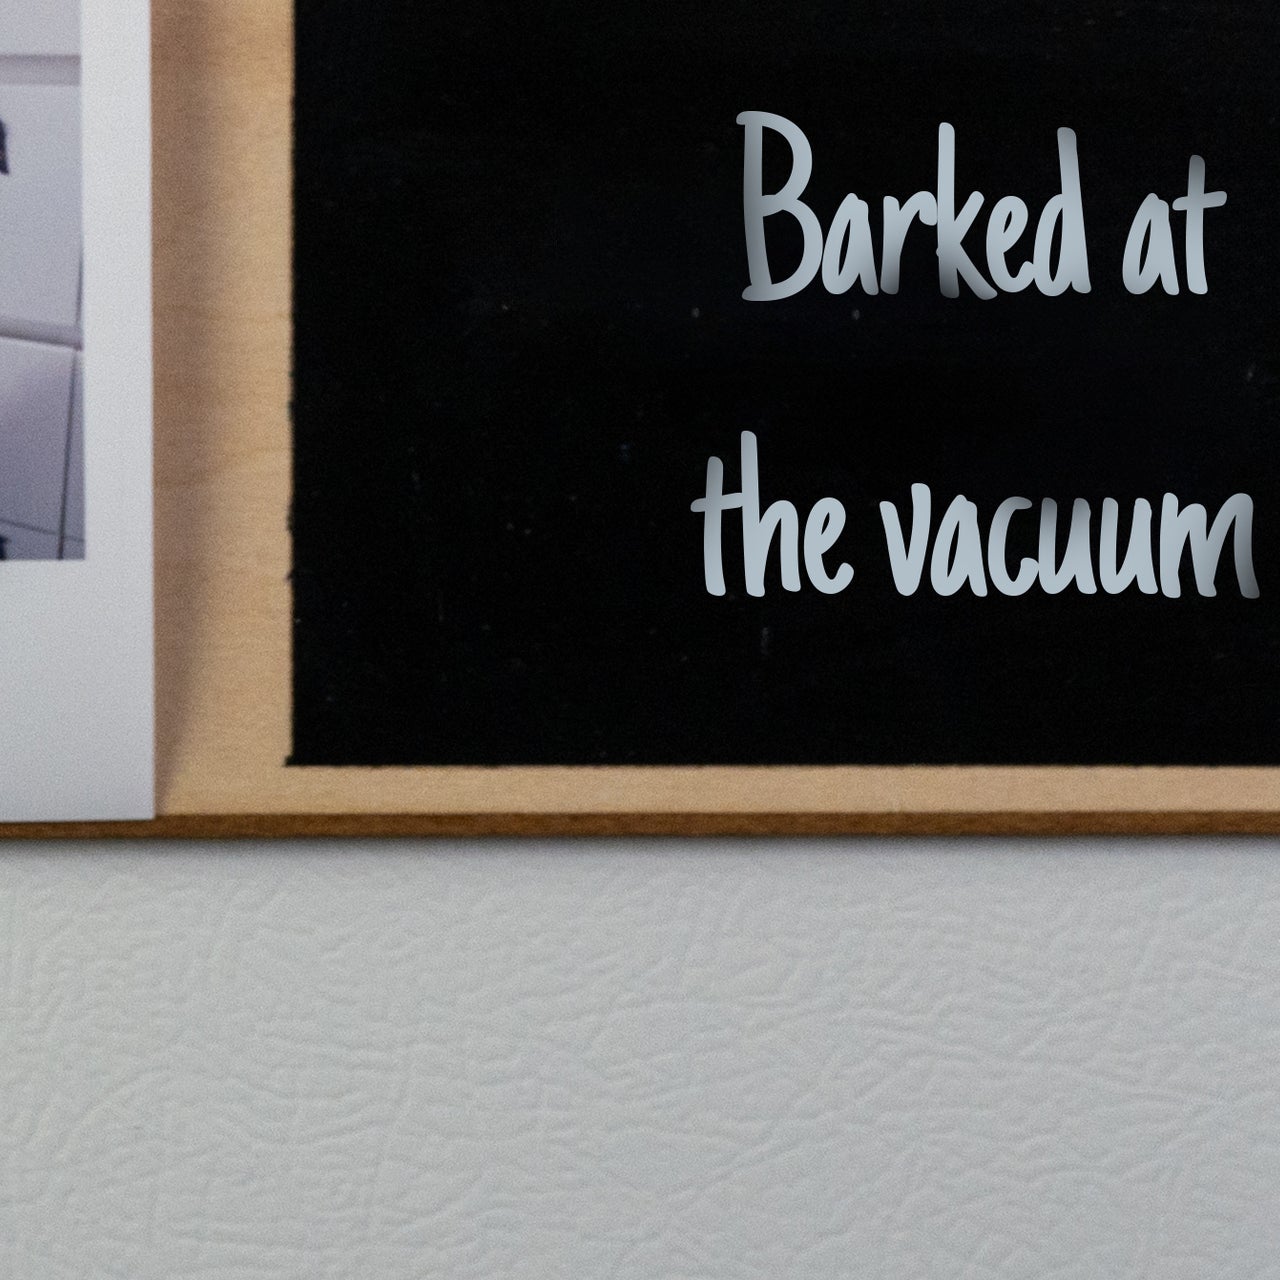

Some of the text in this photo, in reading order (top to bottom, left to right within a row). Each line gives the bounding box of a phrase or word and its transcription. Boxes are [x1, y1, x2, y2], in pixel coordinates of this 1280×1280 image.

[736, 111, 1228, 302] Barked at
[690, 430, 1262, 599] the vacuum
